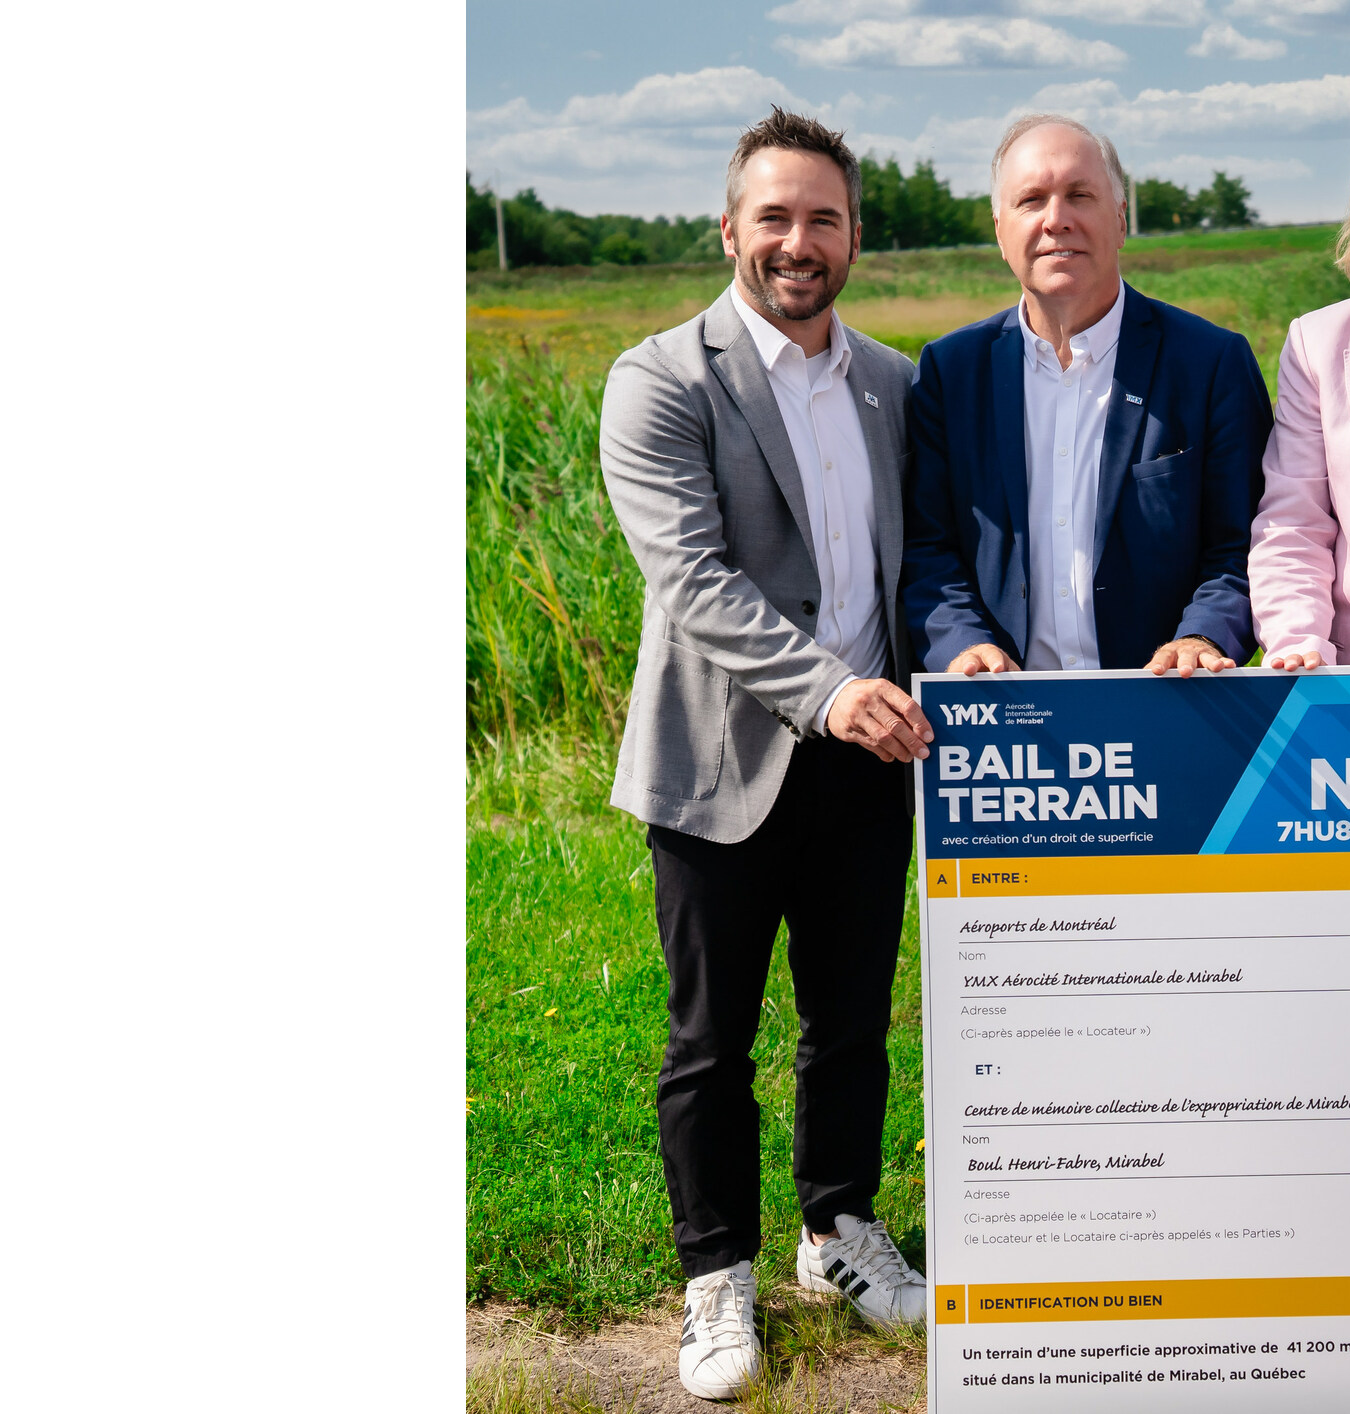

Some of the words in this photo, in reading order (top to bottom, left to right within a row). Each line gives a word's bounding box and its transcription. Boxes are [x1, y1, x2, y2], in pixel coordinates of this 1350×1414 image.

[939, 703, 999, 726] YMX
[939, 744, 1055, 780] BAIL
[1069, 743, 1134, 778] DE
[938, 784, 1157, 822] TERRAIN
[942, 837, 968, 845] avec
[972, 834, 1019, 844] création
[1050, 833, 1077, 843] droit
[1080, 833, 1095, 842] de
[1098, 832, 1153, 843] superficie
[937, 874, 948, 885] A
[972, 872, 1020, 884] ENTRE
[959, 918, 1027, 939] Aéroports
[1029, 917, 1048, 932] de
[1049, 916, 1117, 932] Montréal
[959, 951, 986, 961] Nom
[964, 975, 999, 988] YMX
[1001, 972, 1060, 987] Aérocité
[1061, 970, 1166, 986] Internationale
[1166, 969, 1185, 983] de
[1186, 968, 1243, 983] Mirabel
[960, 1005, 1007, 1015] Adresse
[961, 1028, 1013, 1040] (Ci-après
[1016, 1027, 1061, 1039] appelée
[1064, 1027, 1074, 1037] le
[1086, 1027, 1137, 1036] Locateur
[975, 1064, 993, 1075] ET
[964, 1104, 1011, 1117] Centre
[1011, 1101, 1031, 1116] de
[1031, 1101, 1094, 1115] mémoire
[1095, 1099, 1161, 1114] collective
[1161, 1098, 1180, 1112] de
[1286, 1096, 1305, 1110] de
[963, 1135, 990, 1144] Nom
[968, 1156, 1003, 1171] Boul.
[1008, 1154, 1101, 1172] Henri-Fabre,
[1105, 1153, 1165, 1169] Mirabel
[964, 1189, 1010, 1200] Adresse
[964, 1212, 1016, 1225] (Ci-après
[1019, 1211, 1064, 1224] appelée
[1068, 1211, 1077, 1221] le
[1090, 1210, 1142, 1221] Locataire
[964, 1234, 979, 1245] (le
[982, 1234, 1033, 1244] Locateur
[1036, 1233, 1047, 1243] et
[1050, 1232, 1060, 1242] le
[1063, 1231, 1116, 1242] Locataire
[1119, 1230, 1165, 1242] ci-après
[1168, 1229, 1211, 1241] appelés
[1224, 1229, 1239, 1239] les
[1243, 1228, 1281, 1238] Parties
[947, 1299, 956, 1311] B
[980, 1296, 1098, 1310] IDENTIFICATION
[1103, 1295, 1124, 1307] DU
[1129, 1295, 1162, 1306] BIEN
[963, 1349, 981, 1360] Un
[986, 1347, 1032, 1359] terrain
[1080, 1344, 1150, 1359] superficie
[1154, 1342, 1256, 1358] approximative
[1261, 1342, 1278, 1353] de
[1287, 1341, 1301, 1353] 41
[1306, 1341, 1335, 1352] 200
[963, 1373, 997, 1386] situé
[1001, 1373, 1035, 1385] dans
[1039, 1372, 1051, 1384] la
[1056, 1370, 1143, 1385] municipalité
[1147, 1370, 1165, 1382] de
[1170, 1369, 1225, 1382] Mirabel,
[1230, 1371, 1246, 1380] au
[1251, 1367, 1306, 1380] Québec
